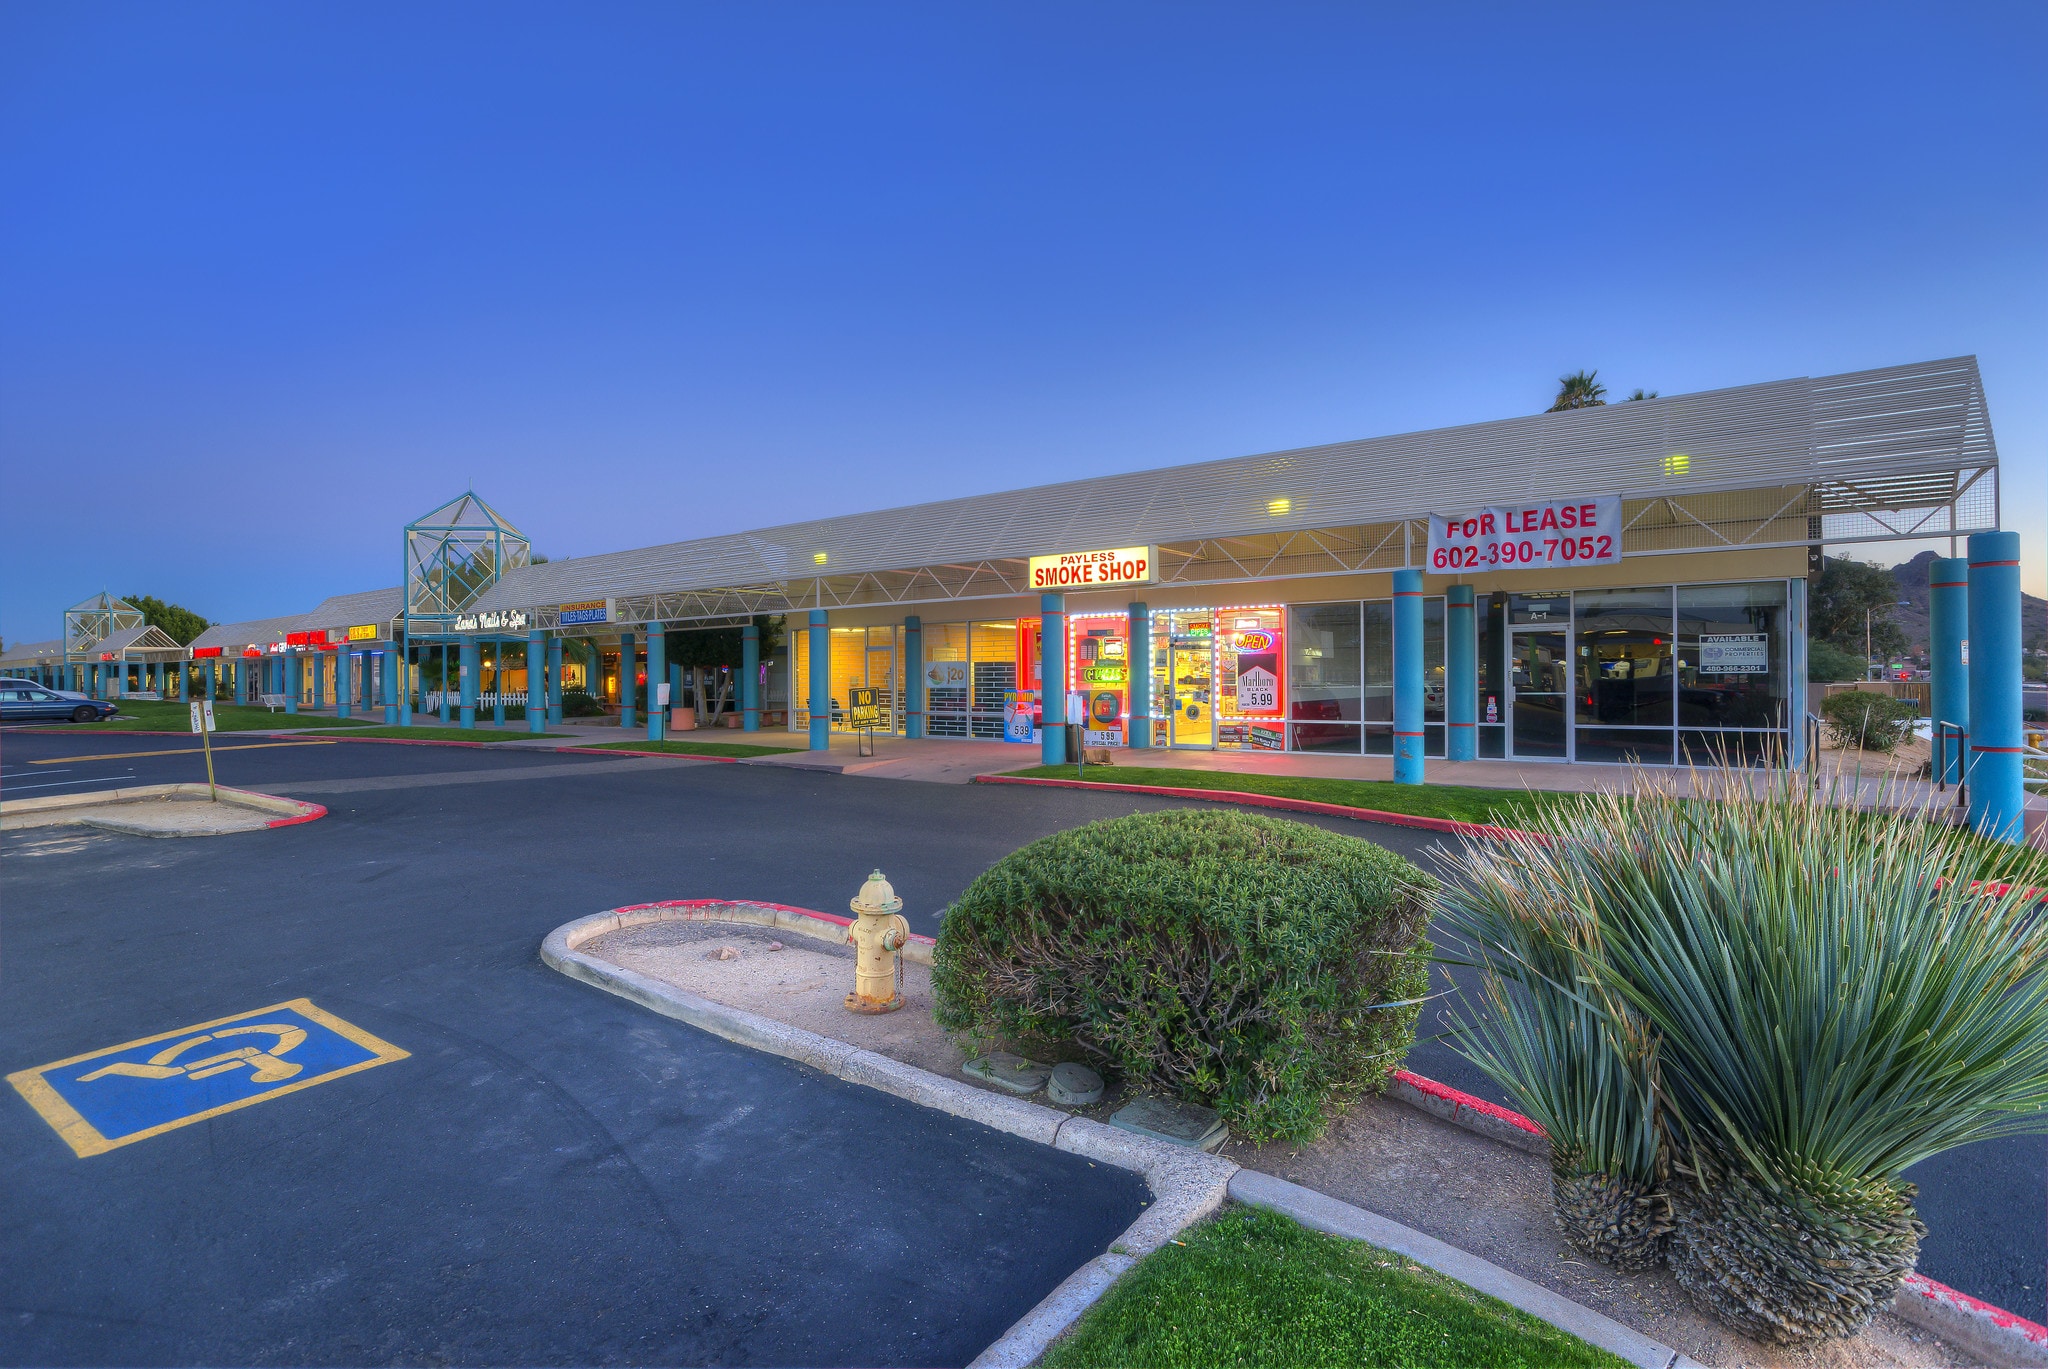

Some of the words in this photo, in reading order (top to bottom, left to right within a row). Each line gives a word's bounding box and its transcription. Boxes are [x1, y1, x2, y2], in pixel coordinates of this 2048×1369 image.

[1446, 513, 1496, 539] FOR
[1506, 504, 1597, 533] LEASE
[1061, 552, 1115, 565] PAYLESS
[1433, 535, 1612, 569] 602-390-7052
[1035, 565, 1093, 587] SMOKE
[1098, 559, 1147, 582] SHOP
[480, 611, 500, 629] Nails
[501, 610, 509, 627] &
[509, 609, 526, 631] Spa
[1530, 612, 1547, 620] A-1
[1235, 634, 1269, 650] OPEN
[1707, 635, 1760, 643] AVAILABLE
[1242, 671, 1274, 687] Marlboro
[858, 690, 872, 705] NO
[1004, 692, 1034, 702] PYRAMID
[1251, 693, 1273, 706] 5.99
[853, 704, 878, 721] PARKING
